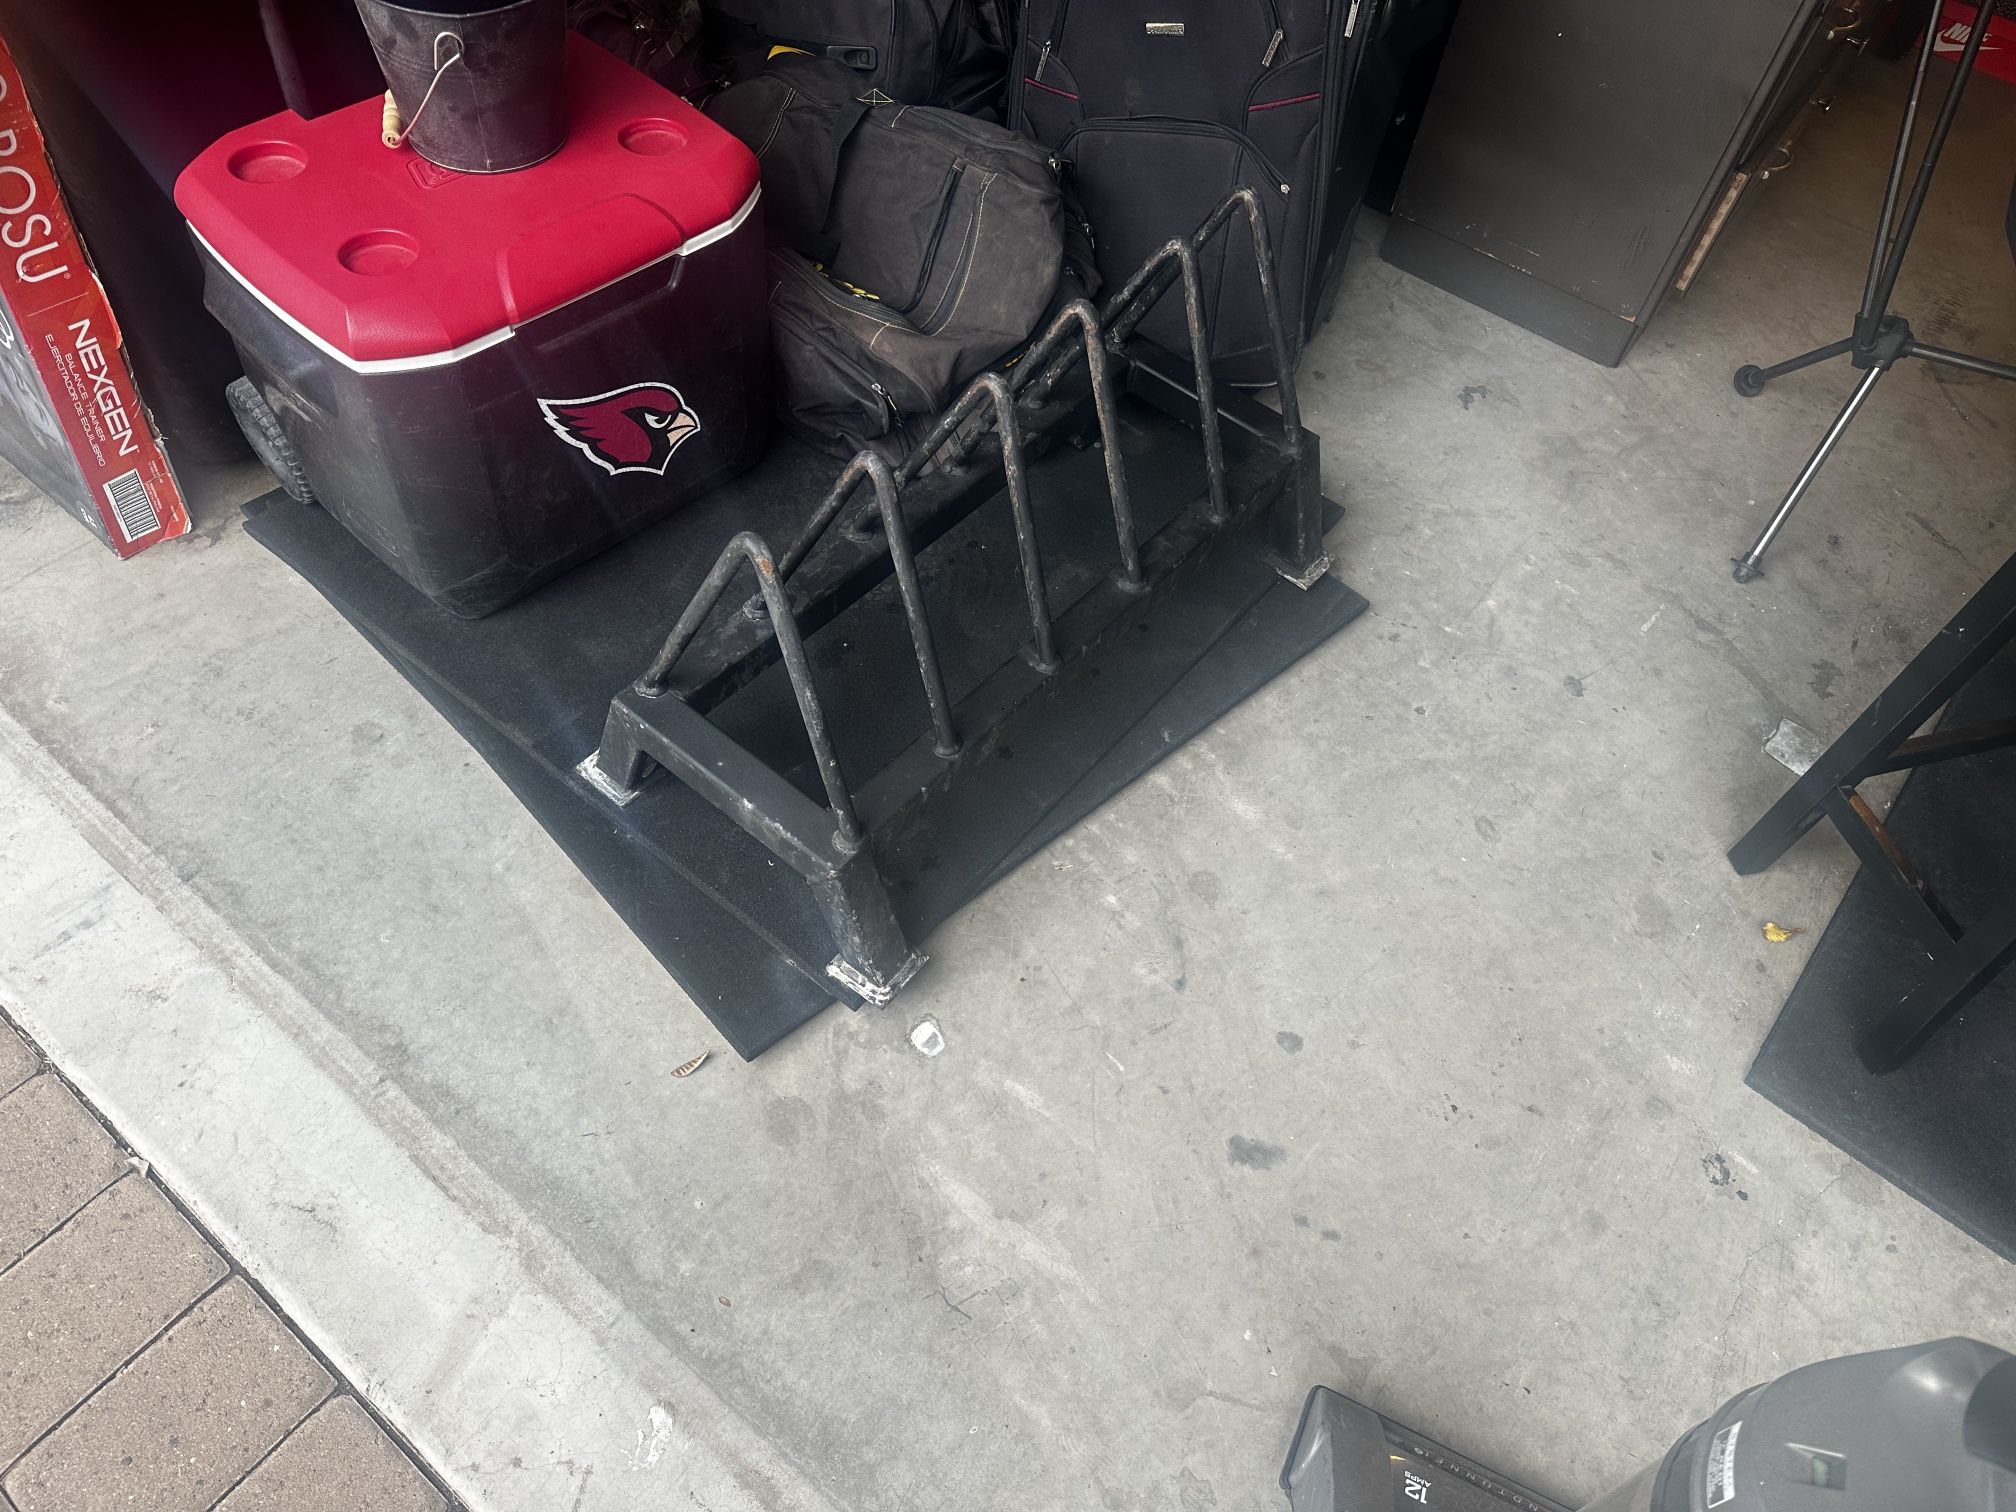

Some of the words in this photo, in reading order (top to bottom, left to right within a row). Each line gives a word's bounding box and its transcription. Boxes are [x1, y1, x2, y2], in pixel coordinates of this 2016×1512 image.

[45, 333, 78, 401] EJERCITADOR
[73, 402, 85, 417] DE
[80, 417, 106, 467] EQUILIBRIO
[64, 352, 89, 400] BALANCE
[85, 401, 106, 442] TRAINER
[68, 318, 138, 456] NEXGEN
[1404, 1470, 1431, 1488] AMPS
[1404, 1478, 1427, 1504] 12
